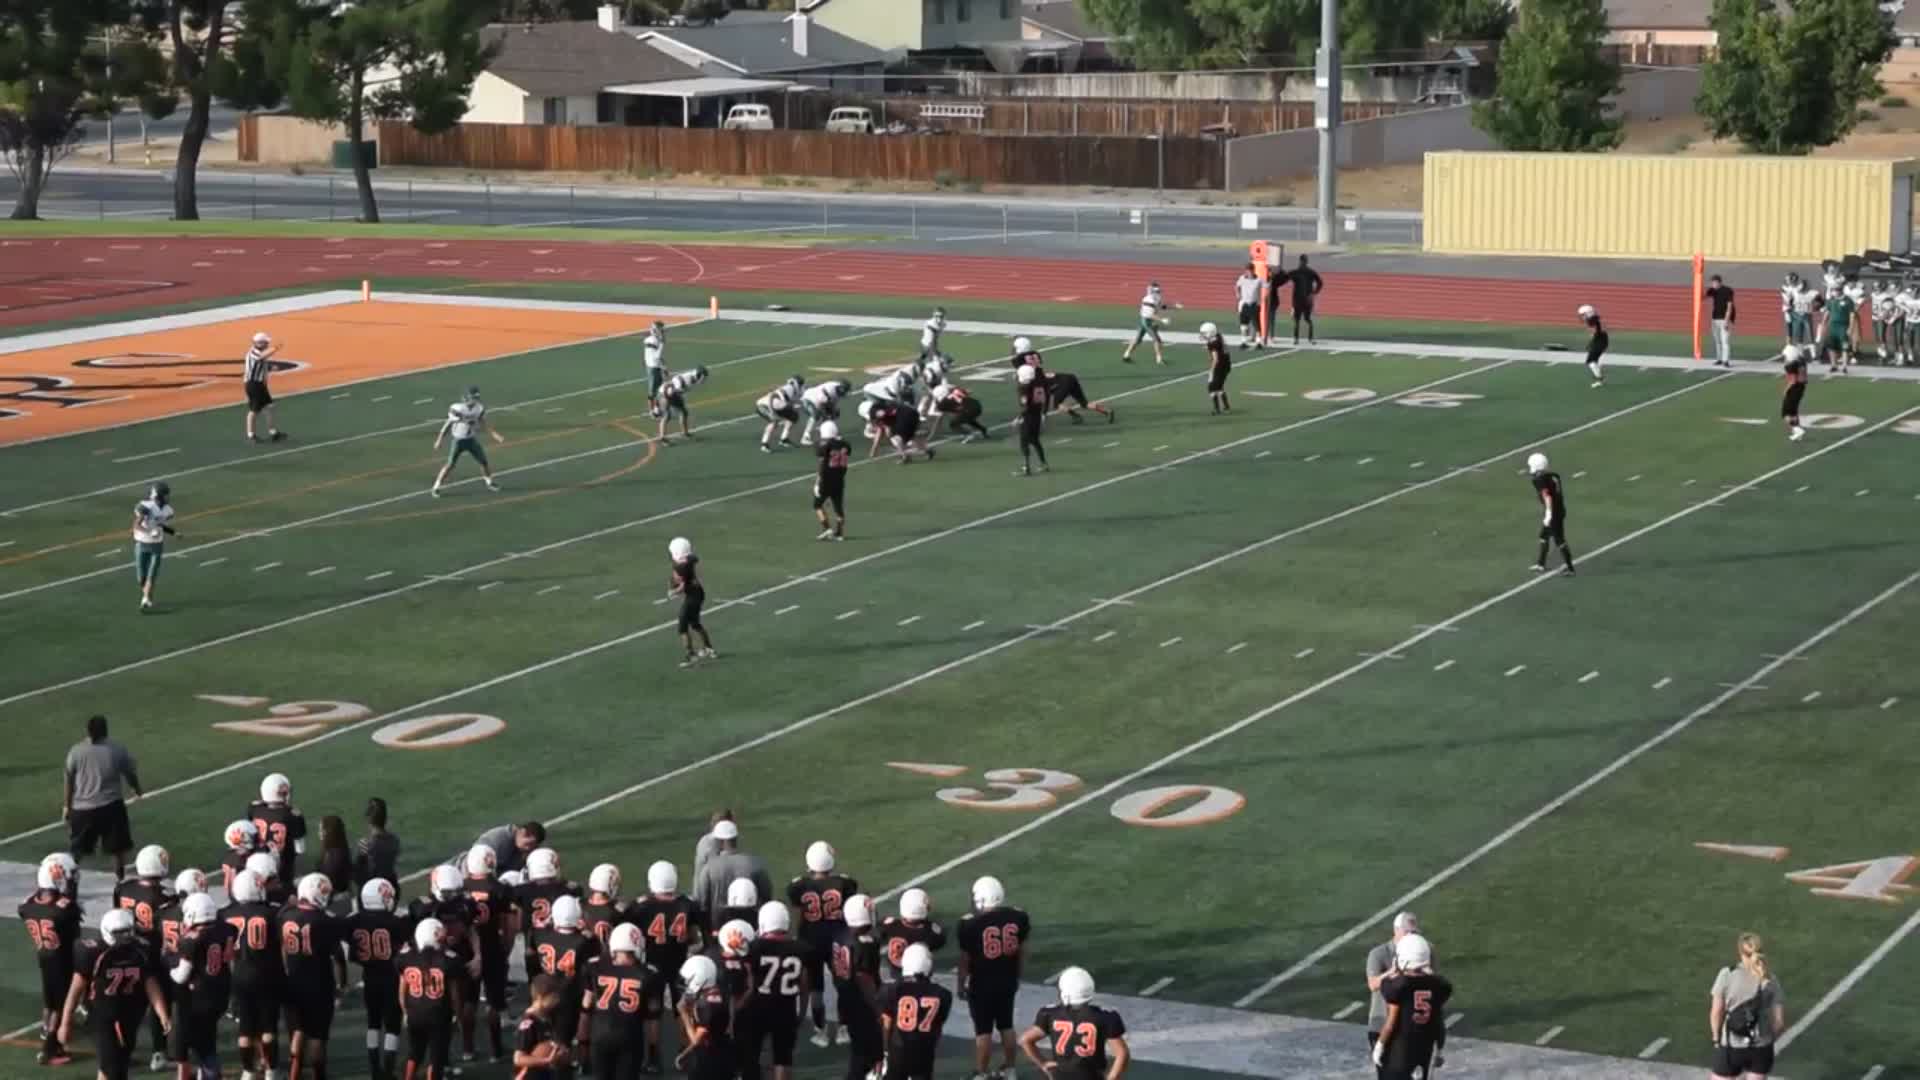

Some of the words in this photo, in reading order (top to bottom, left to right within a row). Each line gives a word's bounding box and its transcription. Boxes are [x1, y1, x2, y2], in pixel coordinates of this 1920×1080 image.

[801, 889, 844, 921] 32
[226, 916, 267, 950] 70
[282, 921, 311, 955] 61
[353, 928, 392, 961] 30
[648, 912, 688, 944] 44
[983, 924, 1019, 959] 66
[538, 944, 576, 977] 34
[758, 956, 802, 995] 72
[106, 967, 140, 996] 77
[597, 976, 641, 1013] 75
[897, 995, 941, 1032] 87
[1413, 990, 1432, 1024] 5
[1052, 1020, 1097, 1057] 73
